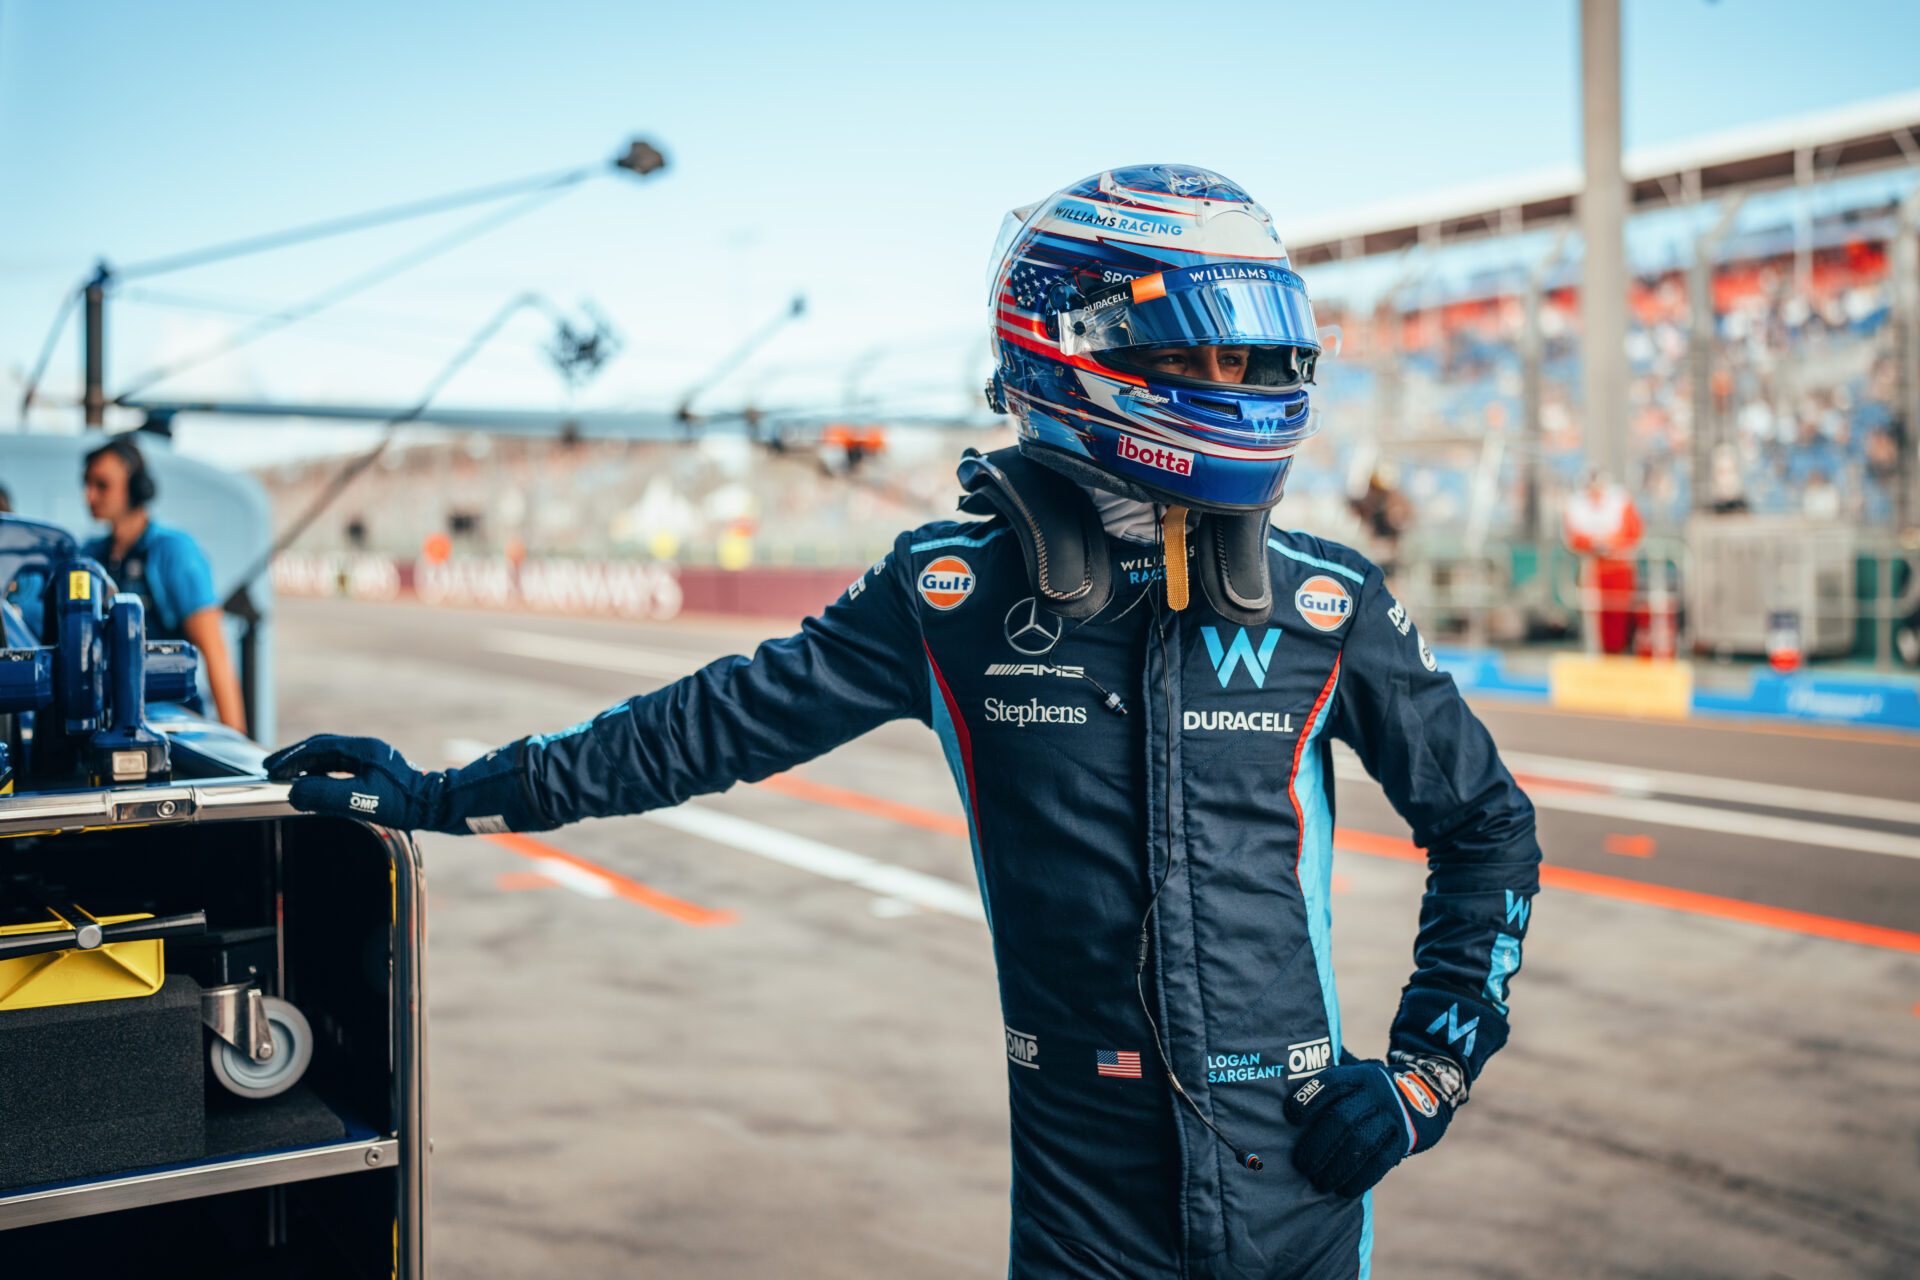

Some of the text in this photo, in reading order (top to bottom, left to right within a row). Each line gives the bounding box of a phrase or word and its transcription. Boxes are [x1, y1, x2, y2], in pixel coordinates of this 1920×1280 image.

[1054, 207, 1183, 236] WILLIAMS RACING
[1189, 268, 1268, 282] WILLIAMS
[1083, 292, 1129, 313] DURACELL
[1118, 434, 1189, 475] ibotta
[922, 574, 972, 591] Gulf
[1299, 594, 1349, 613] Gulf
[984, 697, 1087, 727] Stephens
[1183, 711, 1294, 732] DURACELL
[350, 796, 379, 809] OMP
[1007, 1032, 1039, 1062] OMP
[1207, 1052, 1260, 1069] LOGAN
[1288, 1043, 1331, 1073] OMP
[1207, 1065, 1285, 1083] SARGEANT
[1296, 1079, 1320, 1103] OMP
